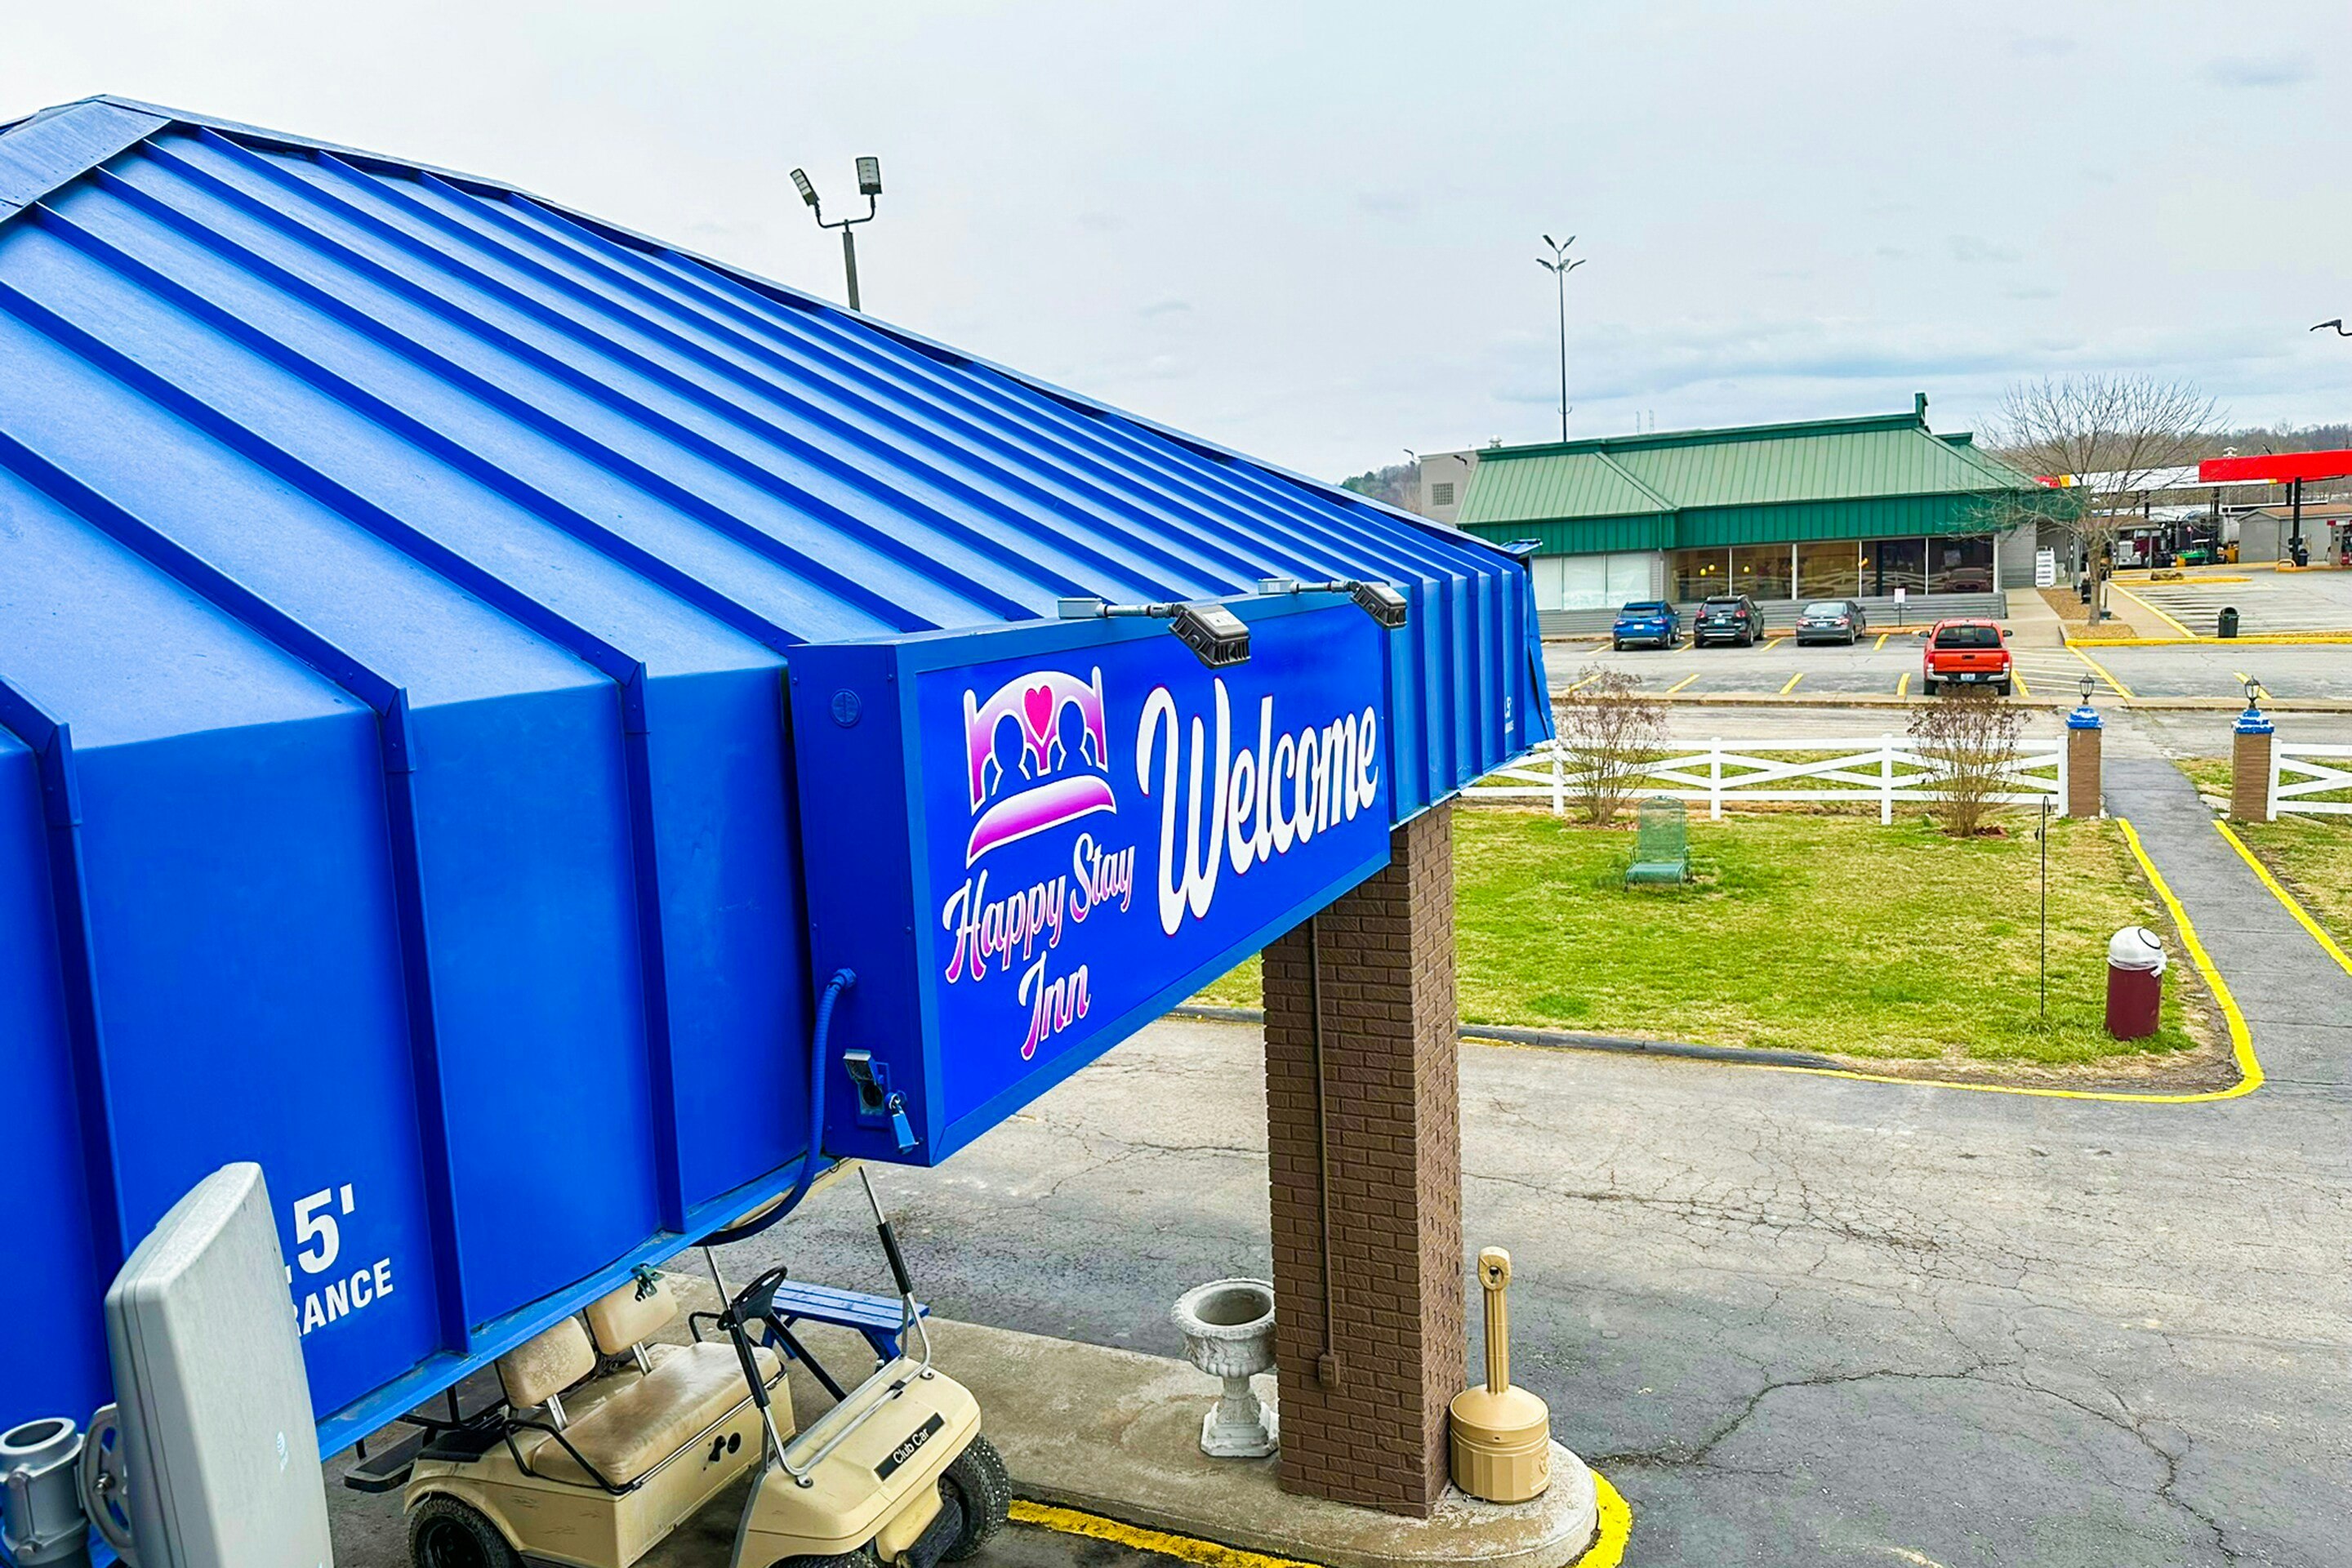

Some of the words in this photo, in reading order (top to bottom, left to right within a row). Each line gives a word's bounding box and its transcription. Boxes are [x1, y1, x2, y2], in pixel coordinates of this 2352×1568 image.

[1136, 677, 1379, 937] Welcome
[942, 869, 1067, 984] Happy
[1069, 832, 1135, 924] Stay
[1018, 951, 1090, 1061] Inn
[893, 1442, 915, 1463] Club
[911, 1428, 929, 1446] Car
